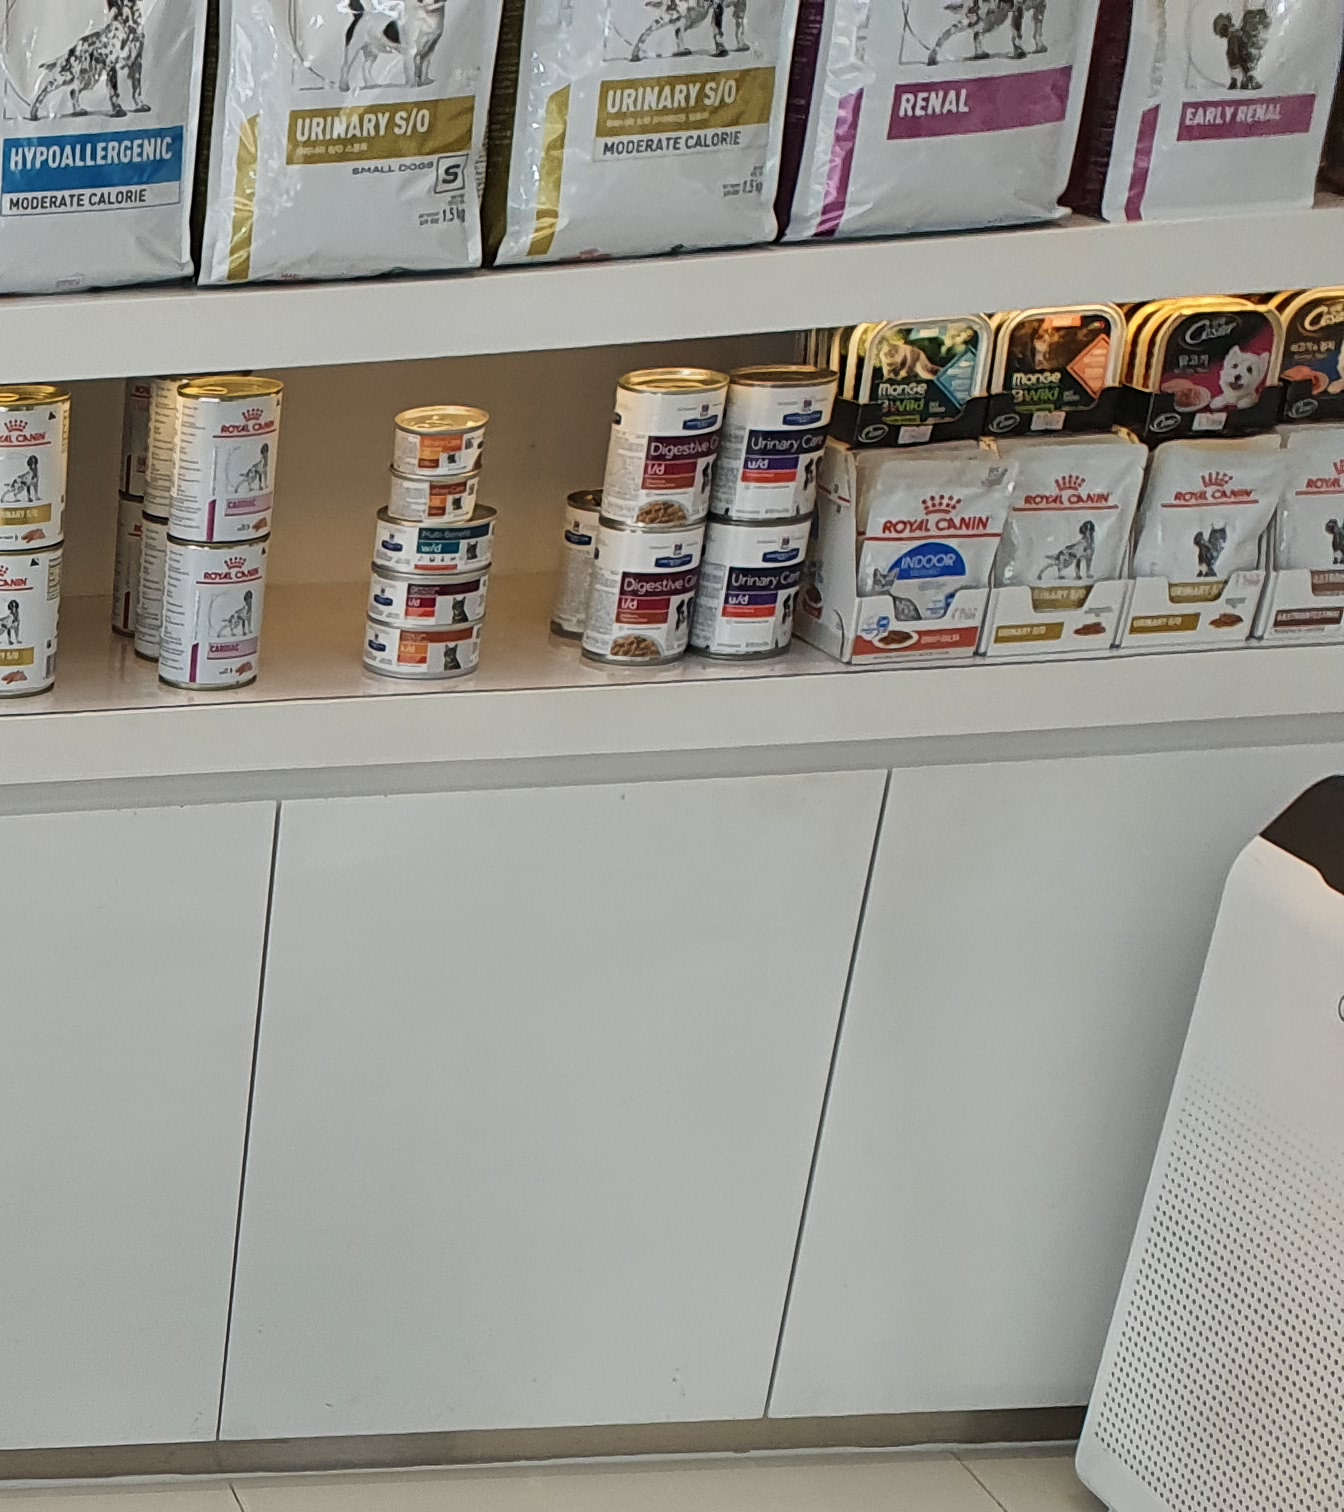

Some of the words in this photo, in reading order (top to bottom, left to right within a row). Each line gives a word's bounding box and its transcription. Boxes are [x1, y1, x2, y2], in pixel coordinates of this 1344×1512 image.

[606, 82, 701, 113] URINARY
[703, 79, 736, 107] S/O
[898, 88, 970, 118] RENAL
[1184, 105, 1233, 127] EARLY
[1233, 103, 1283, 123] RENAL
[296, 111, 390, 142] URINARY
[394, 108, 430, 136] S/O
[603, 136, 681, 156] MODERATE
[685, 131, 741, 150] CALORIE
[10, 136, 173, 171] HYPOALLERGENIC
[352, 165, 394, 175] SMALL
[398, 161, 434, 171] DOGS
[441, 164, 460, 184] S
[9, 193, 85, 211] MODERATE
[89, 188, 146, 206] CALORIE
[442, 208, 455, 223] 1.5
[221, 423, 250, 434] ROYAL
[253, 419, 275, 431] CANIN
[16, 433, 46, 442] CANIN
[751, 434, 800, 451] Urinary
[650, 441, 710, 458] Digestive
[1024, 494, 1064, 506] ROYAL
[1067, 493, 1110, 505] CANIN
[882, 518, 931, 535] ROYAL
[935, 516, 990, 532] CANIN
[901, 553, 956, 569] INDOOR
[204, 570, 233, 581] ROYAL
[236, 567, 260, 579] CANIN
[732, 572, 779, 587] Urinary
[624, 578, 683, 591] Digestive
